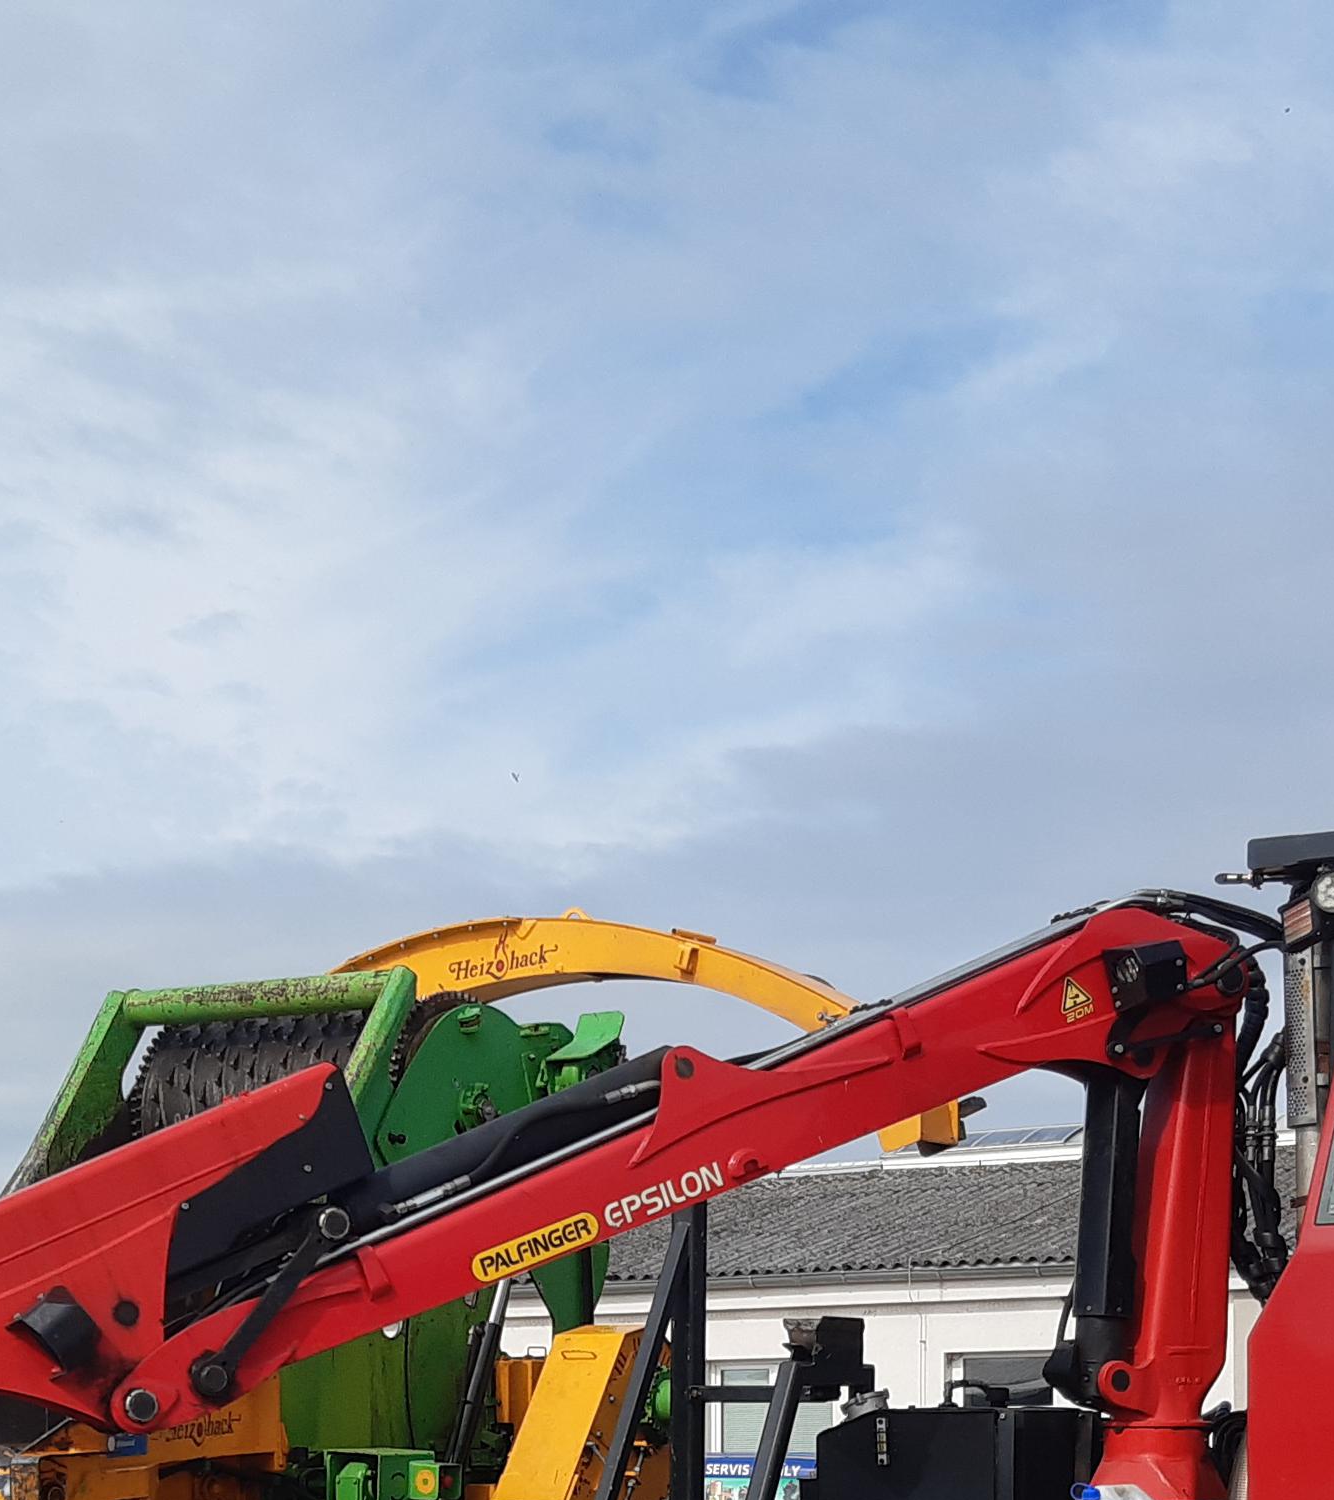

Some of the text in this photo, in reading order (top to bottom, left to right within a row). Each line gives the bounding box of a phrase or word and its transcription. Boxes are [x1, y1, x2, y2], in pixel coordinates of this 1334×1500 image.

[479, 1161, 725, 1278] PALFINGER EPSILON
[705, 1463, 750, 1476] SERVIS
